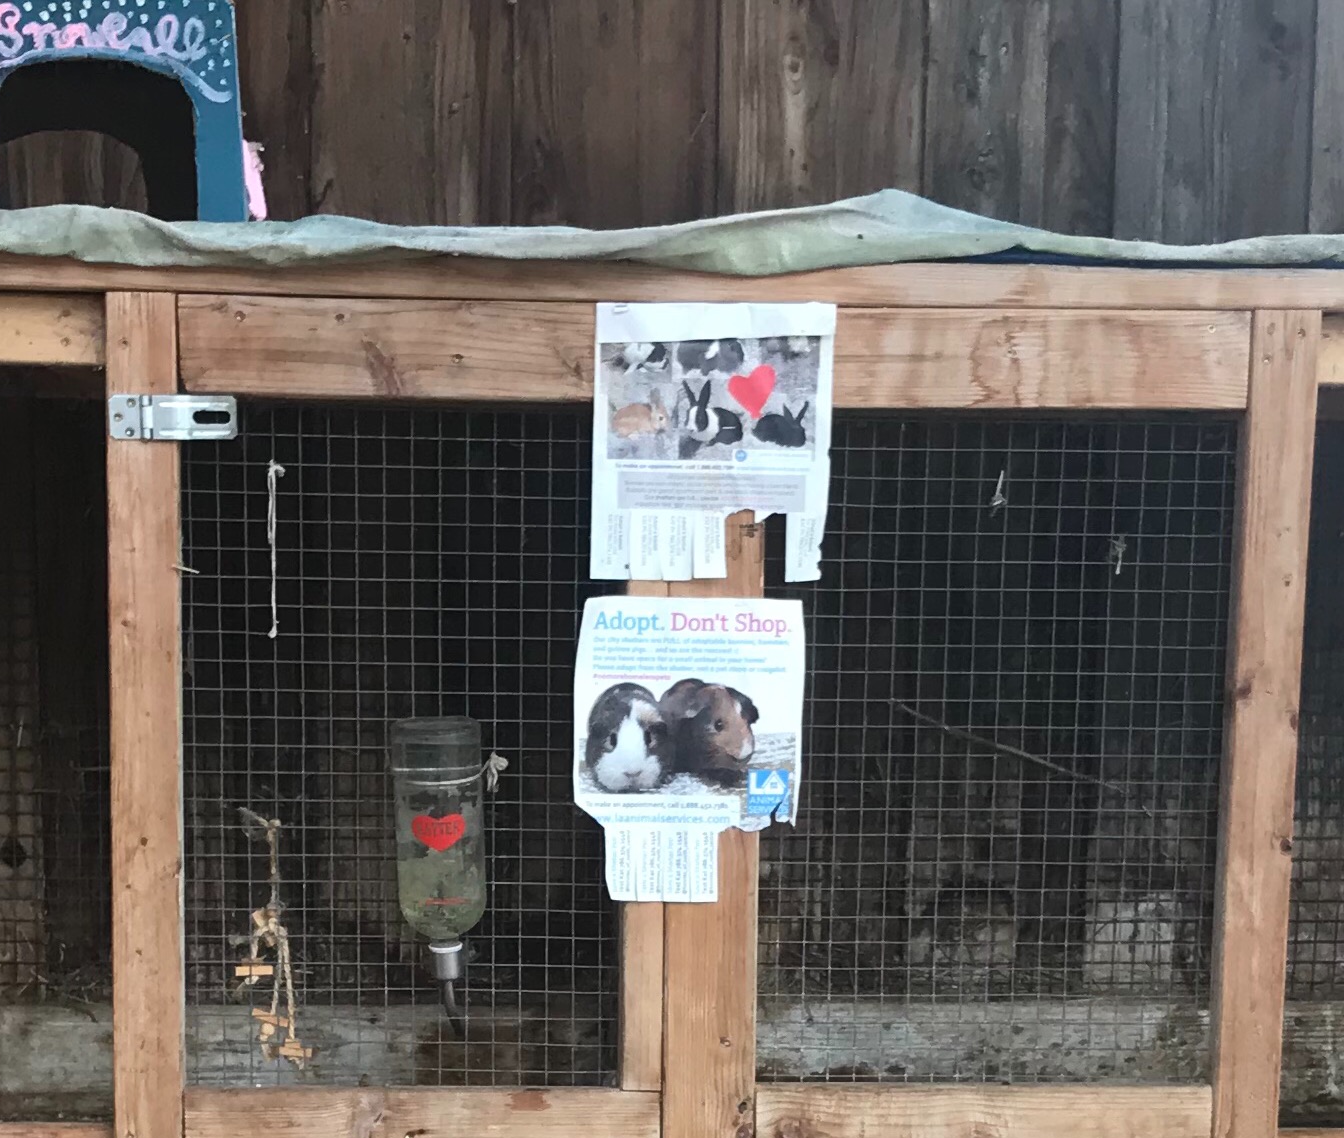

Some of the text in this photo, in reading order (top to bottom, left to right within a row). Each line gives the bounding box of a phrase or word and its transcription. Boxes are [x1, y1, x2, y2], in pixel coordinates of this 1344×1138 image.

[593, 611, 792, 637] Adopt. Don't Shop.
